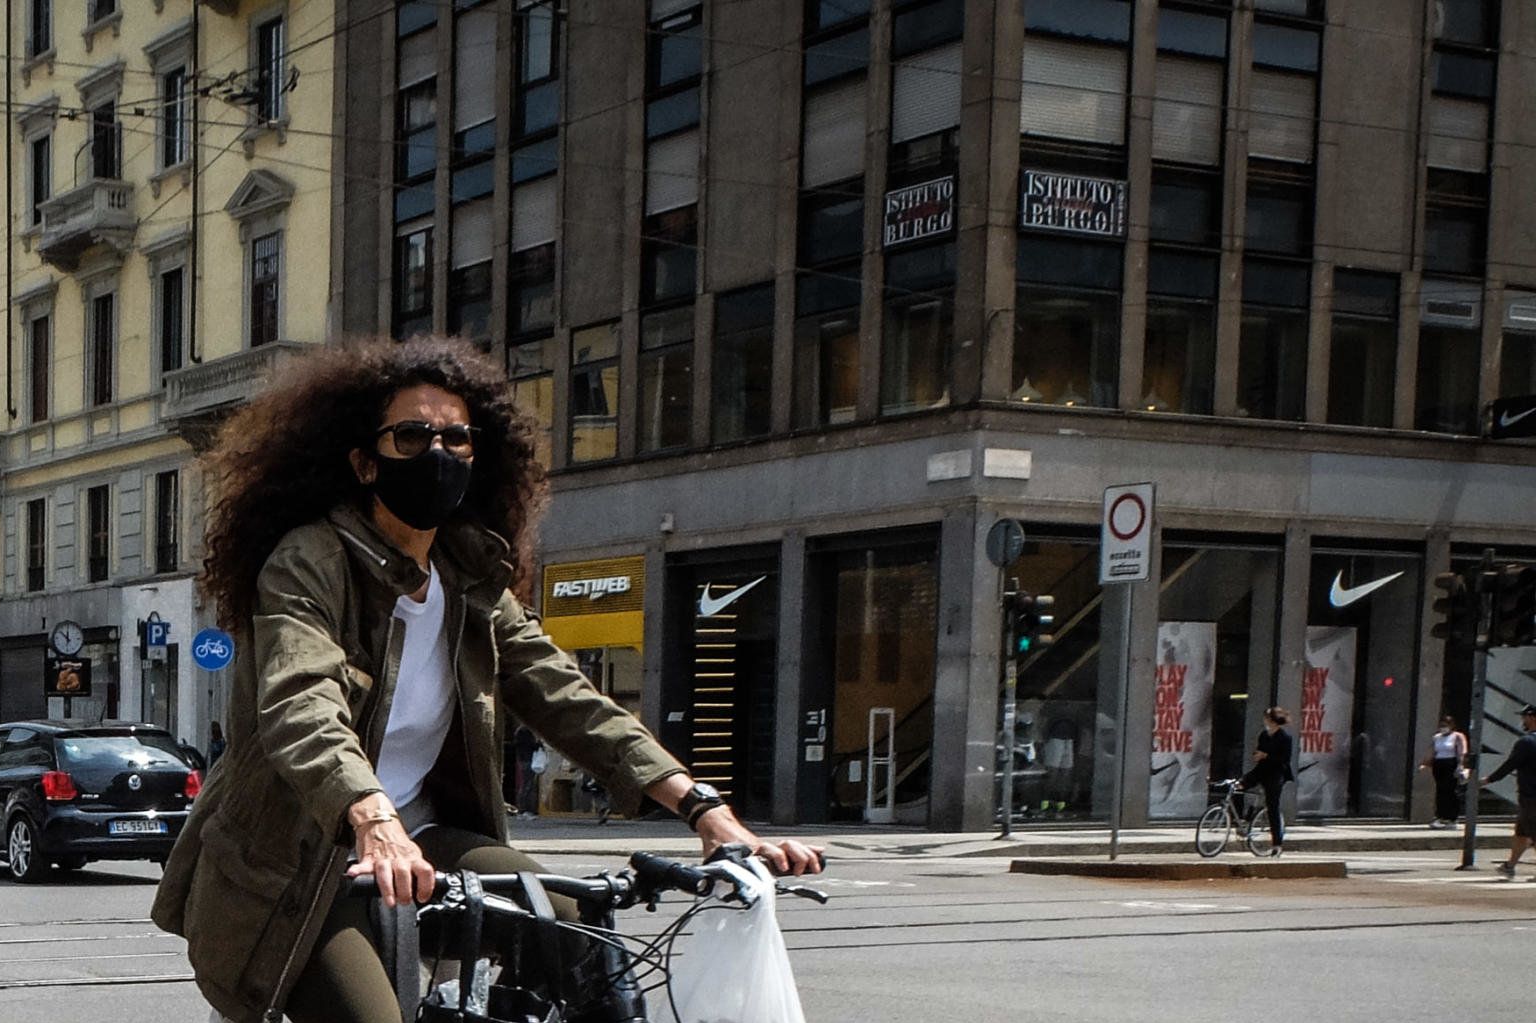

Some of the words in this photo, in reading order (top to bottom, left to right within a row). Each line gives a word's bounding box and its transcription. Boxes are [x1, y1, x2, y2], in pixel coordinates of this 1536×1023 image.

[887, 180, 953, 213] ISTITUTO
[1028, 173, 1112, 205] ISTITUTO
[886, 211, 951, 243] BURGO
[1033, 203, 1107, 231] BURGO
[553, 576, 631, 600] FASTWEB
